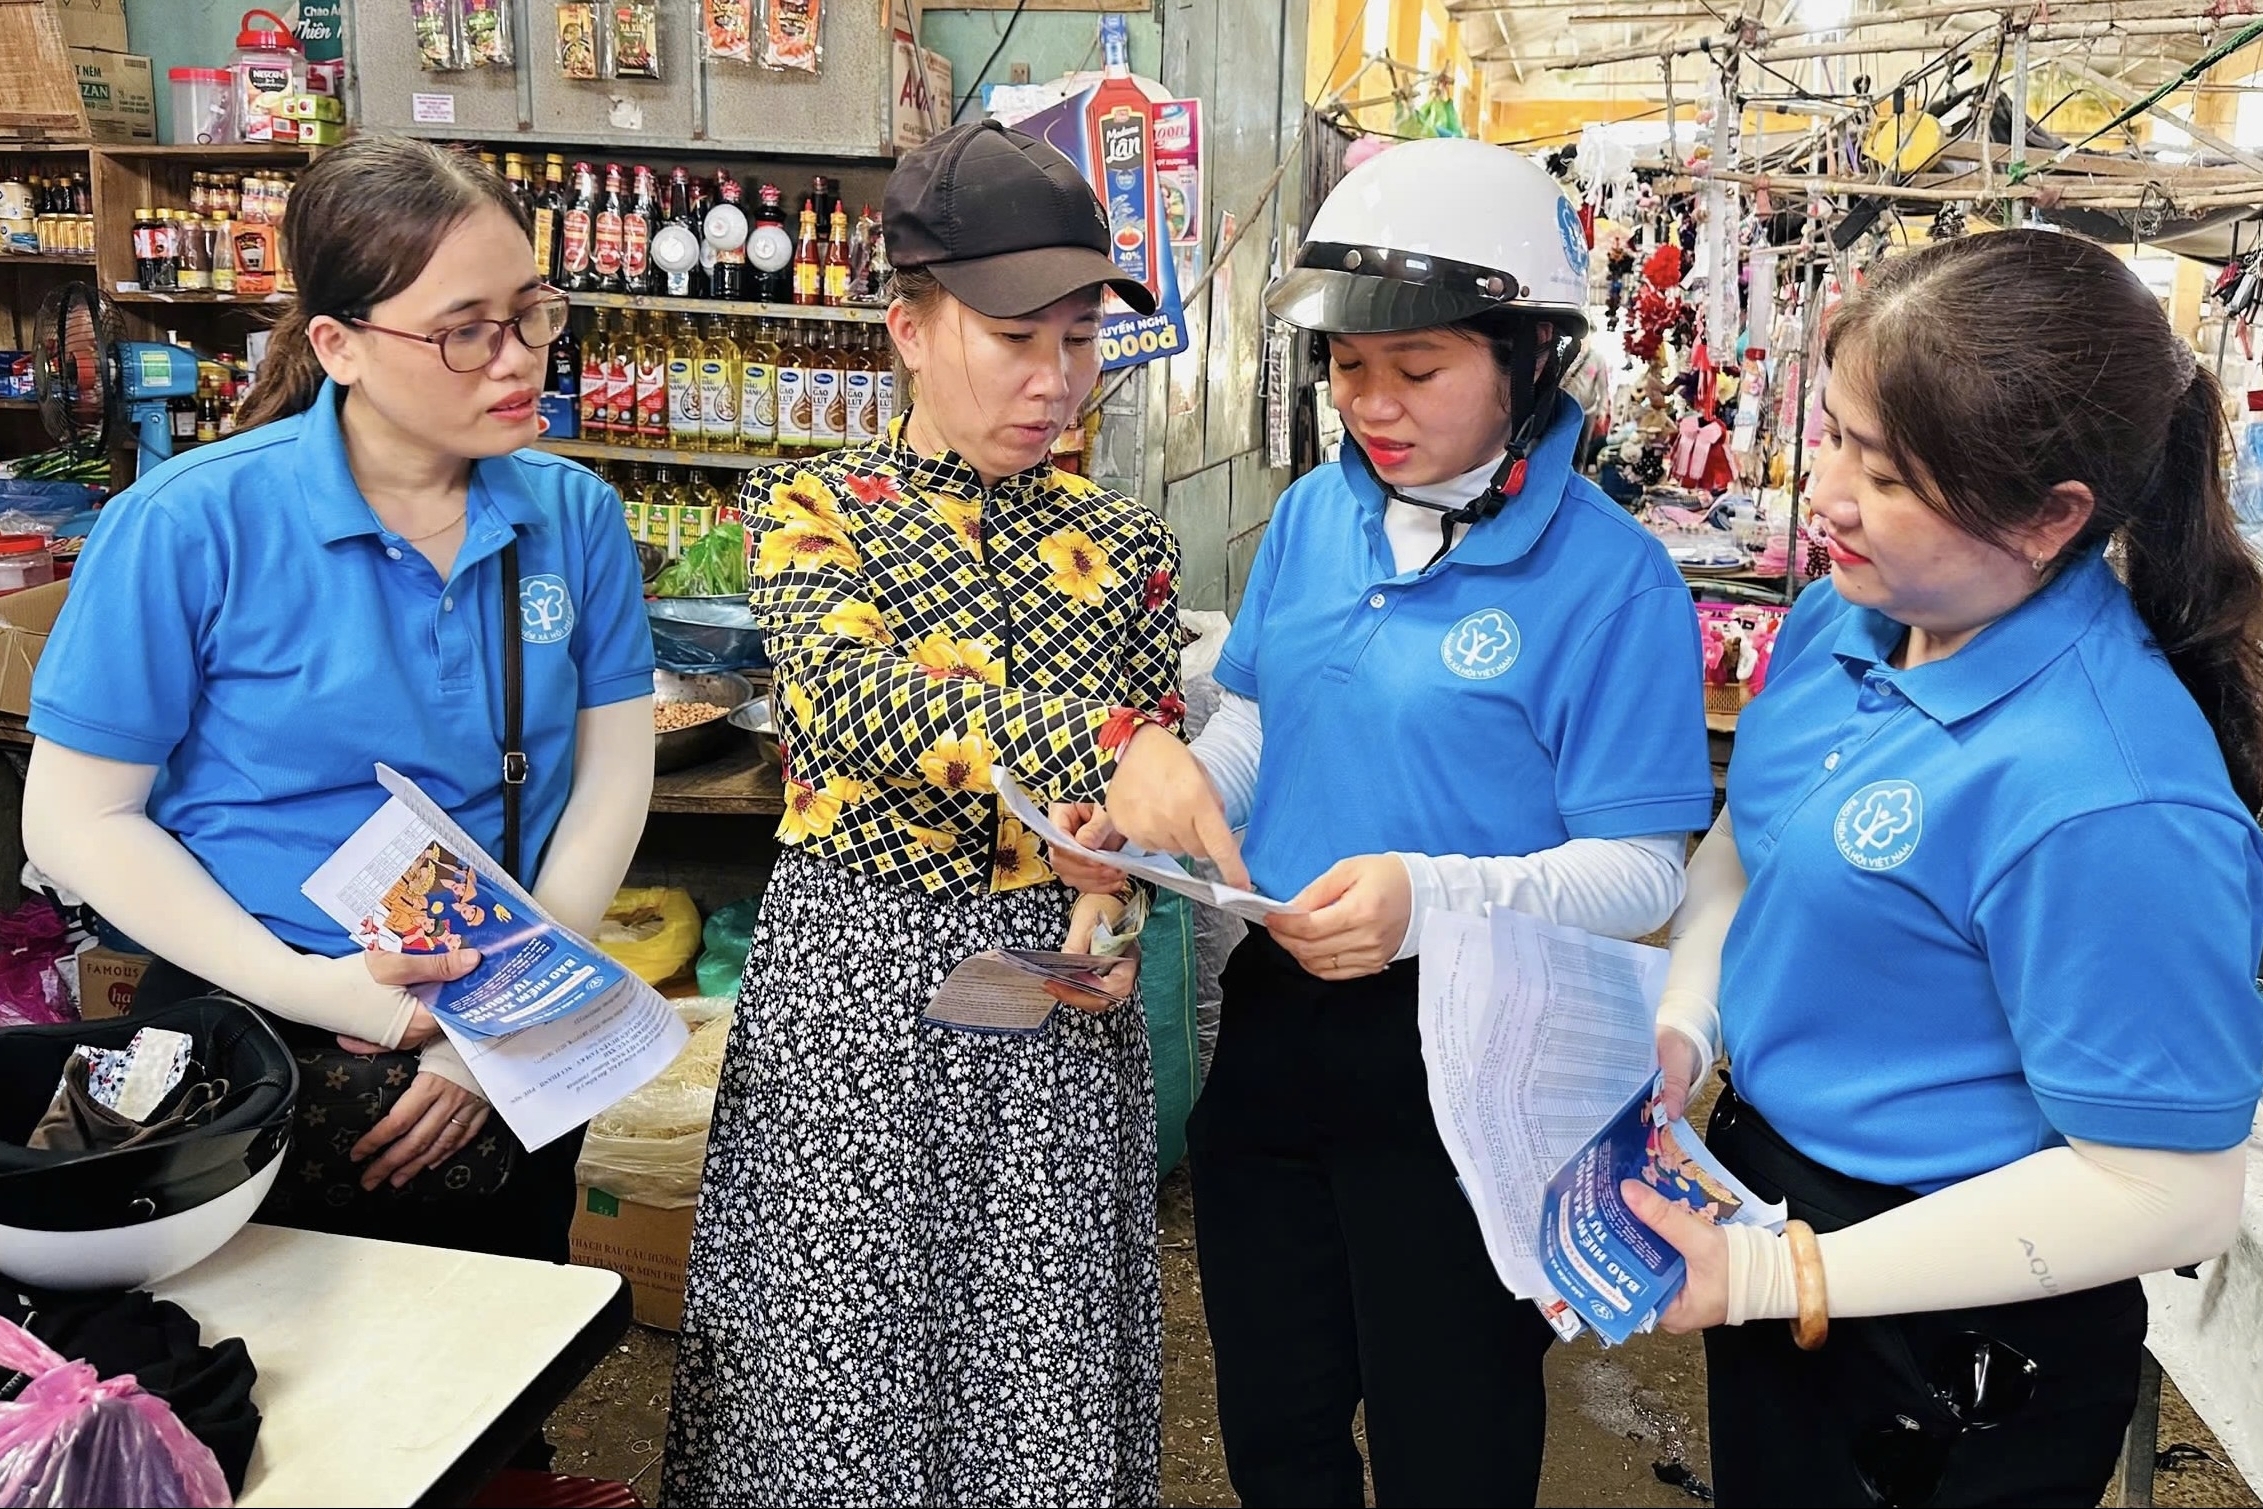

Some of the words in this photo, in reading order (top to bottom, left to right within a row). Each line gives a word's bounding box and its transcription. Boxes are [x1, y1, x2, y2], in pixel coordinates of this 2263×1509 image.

[82, 84, 108, 97] ZAN
[1120, 251, 1141, 261] 40%
[1101, 324, 1178, 361] 000đ
[1891, 843, 1911, 863] NAM
[87, 964, 139, 977] FAMOUS
[548, 957, 576, 981] BẢO
[514, 977, 532, 995] TỰ
[514, 977, 548, 1003] HIỂM
[492, 999, 515, 1015] XÃ
[1574, 1215, 1607, 1262] HIỂM
[1588, 1219, 1608, 1243] TỰ
[572, 1253, 590, 1263] NUT
[663, 1272, 683, 1282] FRU
[1606, 1260, 1640, 1293] BẢO
